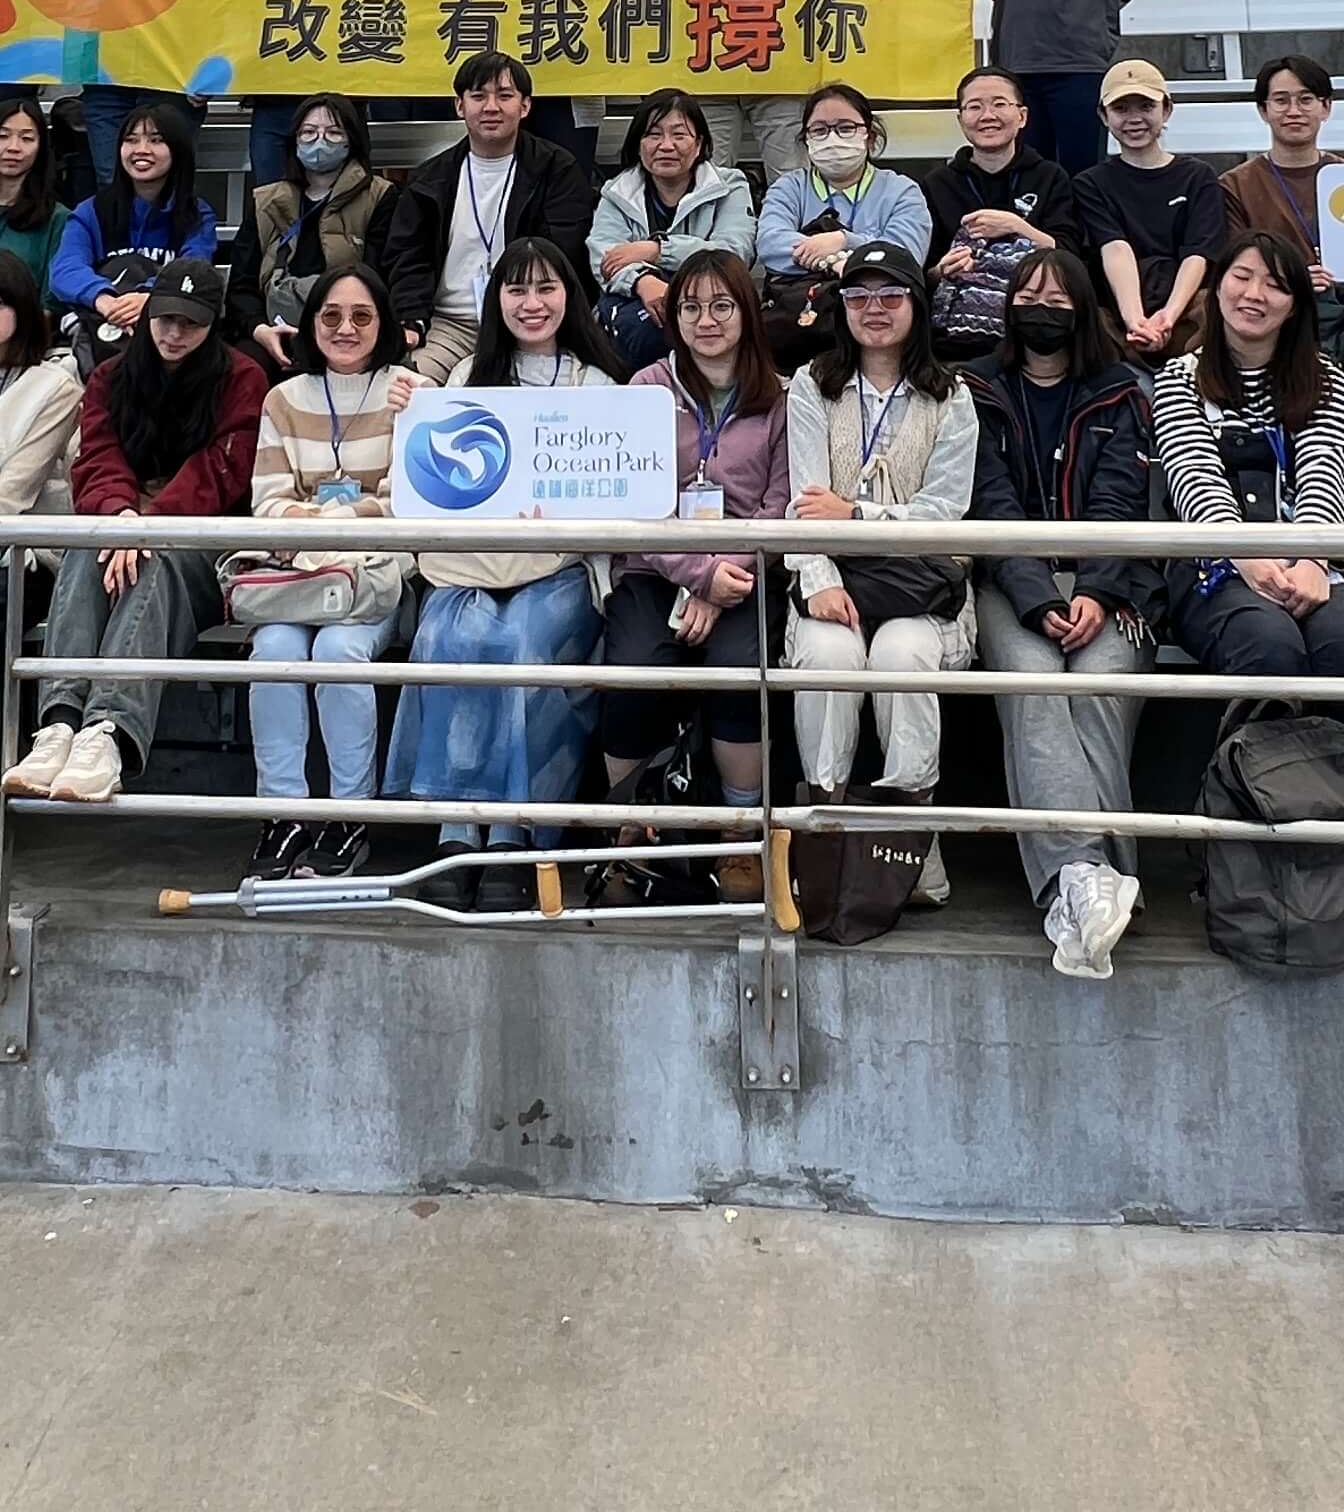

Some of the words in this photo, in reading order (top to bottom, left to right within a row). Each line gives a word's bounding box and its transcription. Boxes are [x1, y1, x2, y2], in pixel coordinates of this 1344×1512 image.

[535, 425, 627, 451] Farglory
[533, 452, 610, 473] Ocean
[616, 450, 665, 472] Park
